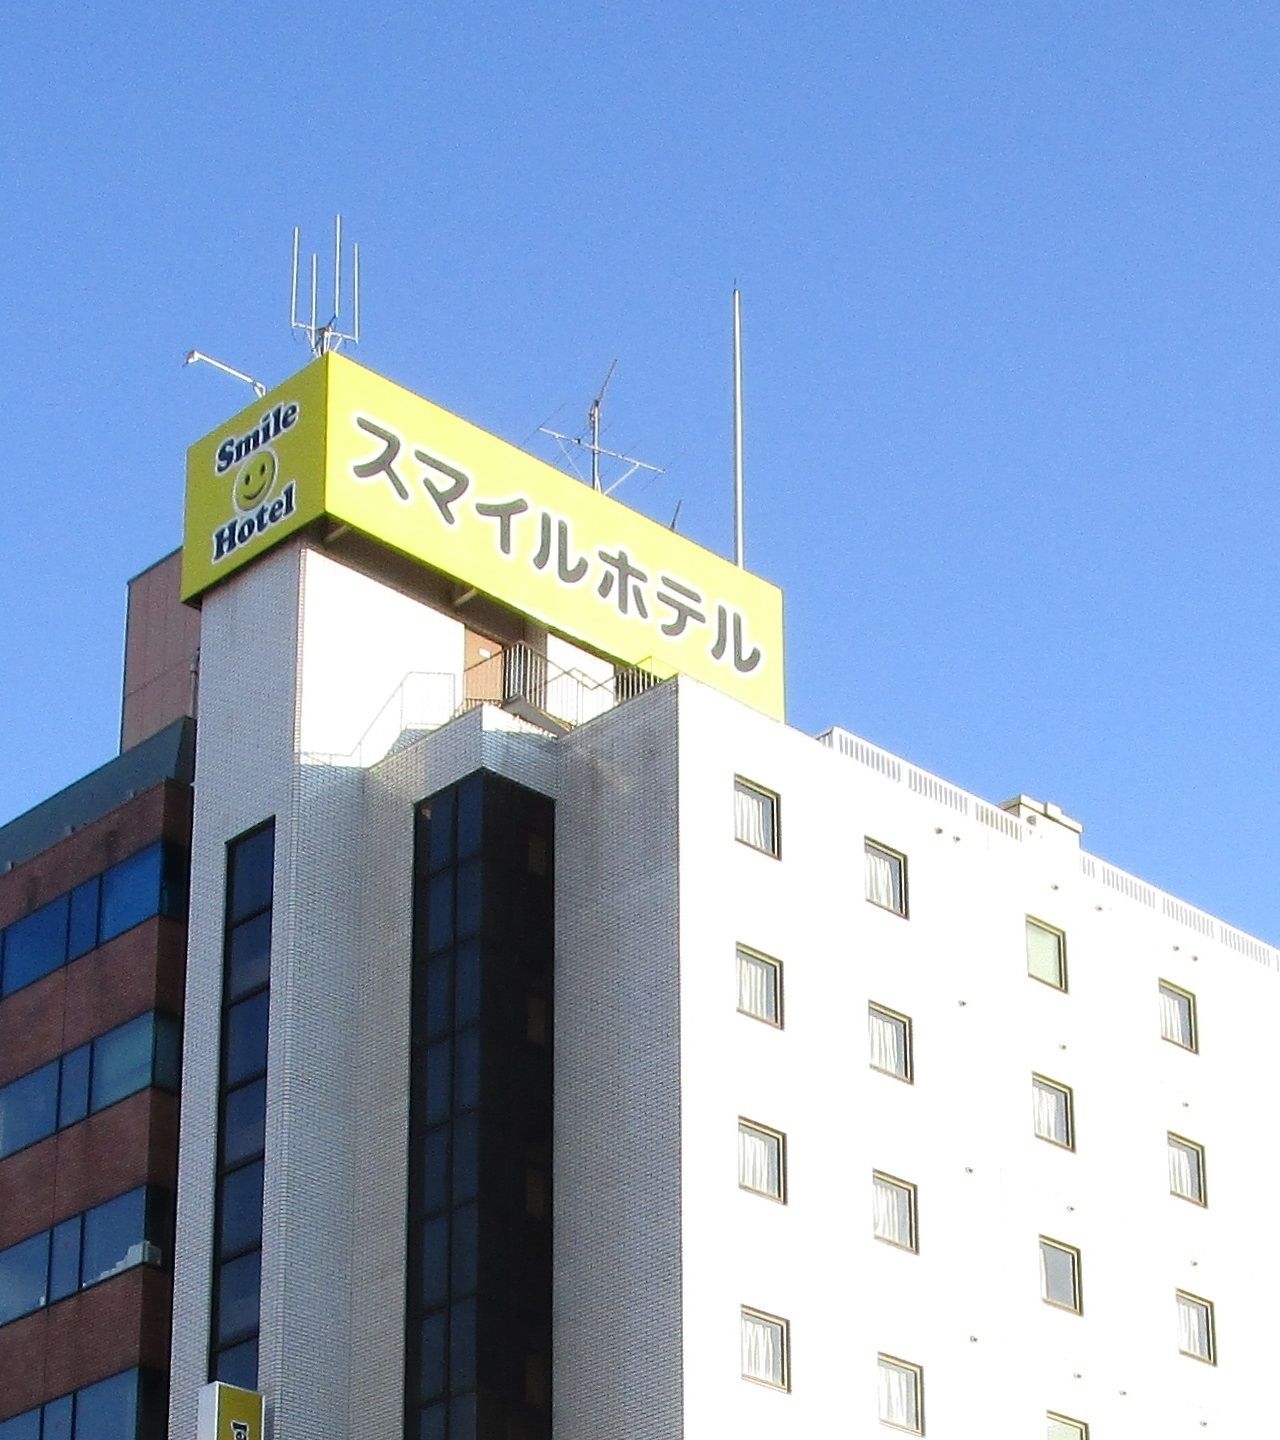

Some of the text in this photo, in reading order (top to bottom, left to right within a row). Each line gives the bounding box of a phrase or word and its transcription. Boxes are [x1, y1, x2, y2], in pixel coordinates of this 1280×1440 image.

[216, 402, 298, 474] Smile
[213, 481, 295, 561] Hotel
[352, 416, 762, 673] スマイルホテル
